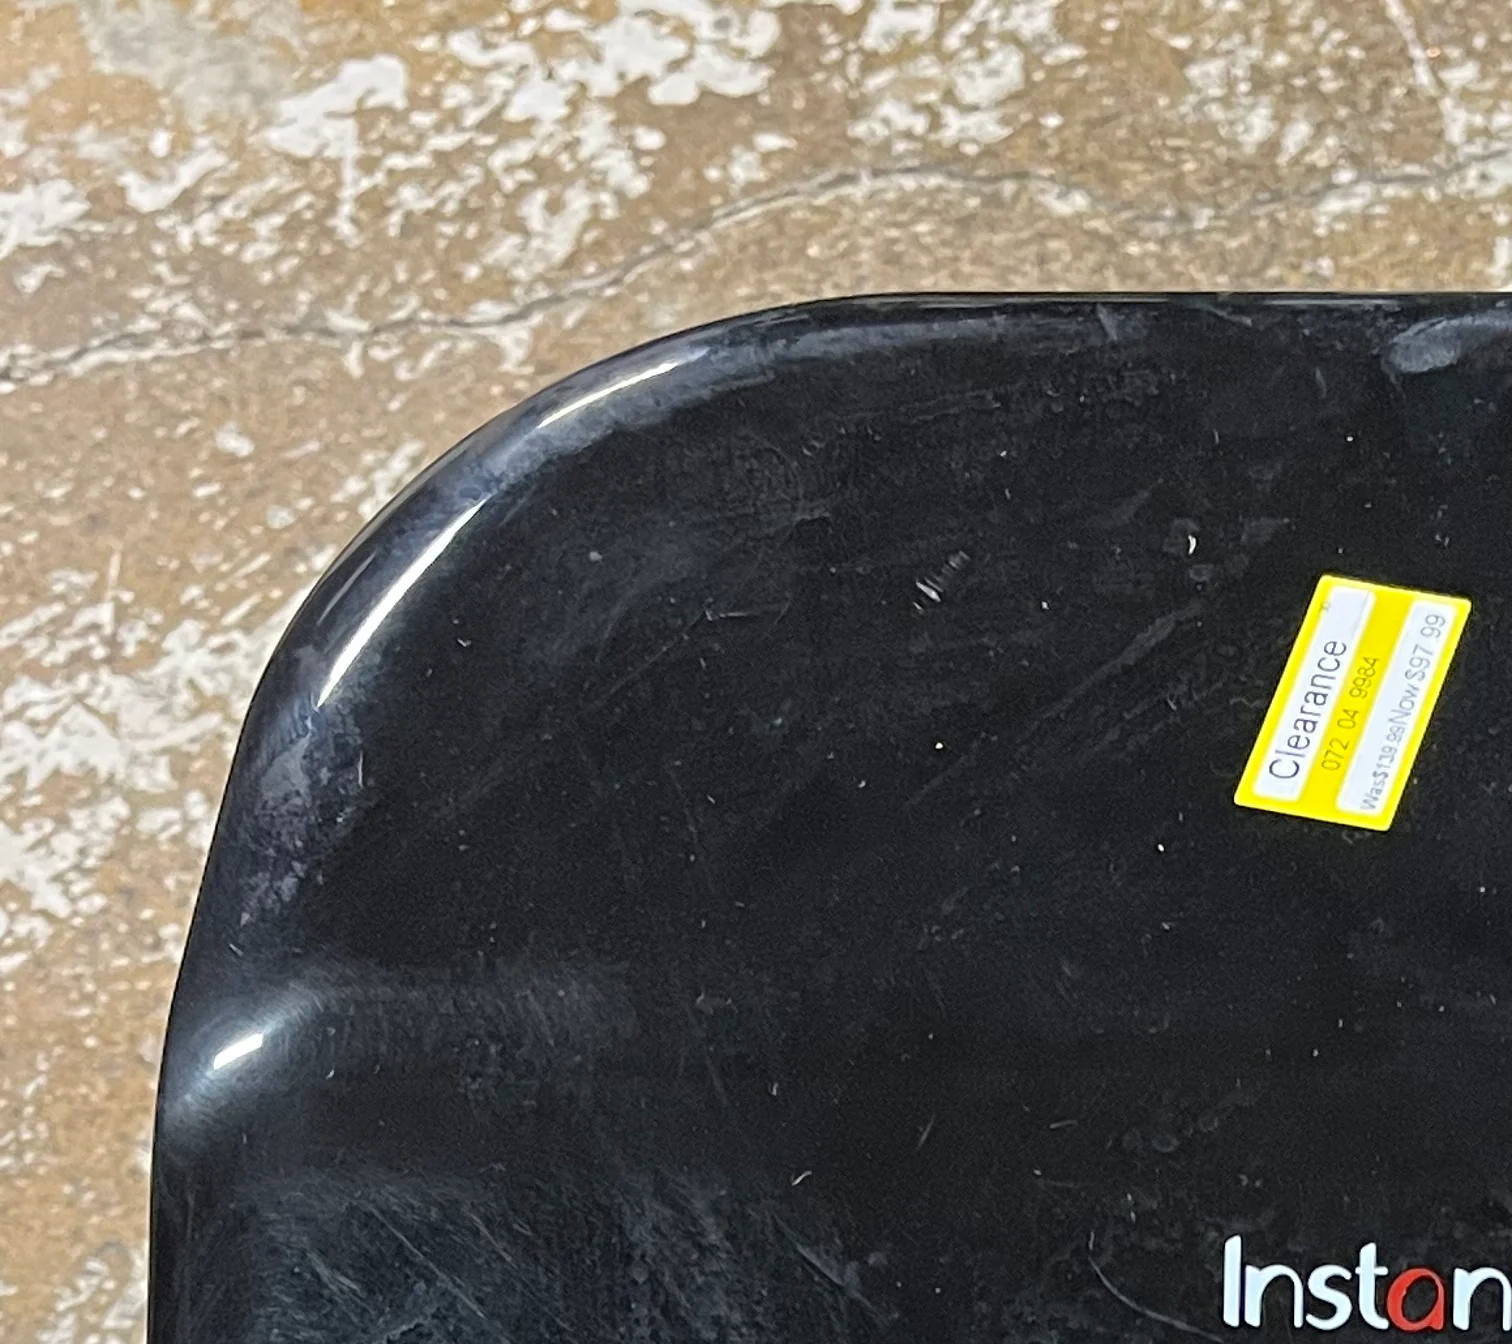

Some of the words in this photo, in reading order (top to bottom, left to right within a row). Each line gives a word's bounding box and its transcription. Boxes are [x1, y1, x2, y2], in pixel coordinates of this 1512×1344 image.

[1404, 613, 1446, 682] $9799
[1269, 640, 1347, 779] Clearance
[1321, 738, 1350, 771] 072
[1337, 708, 1360, 729] 04
[1349, 656, 1380, 699] 9984
